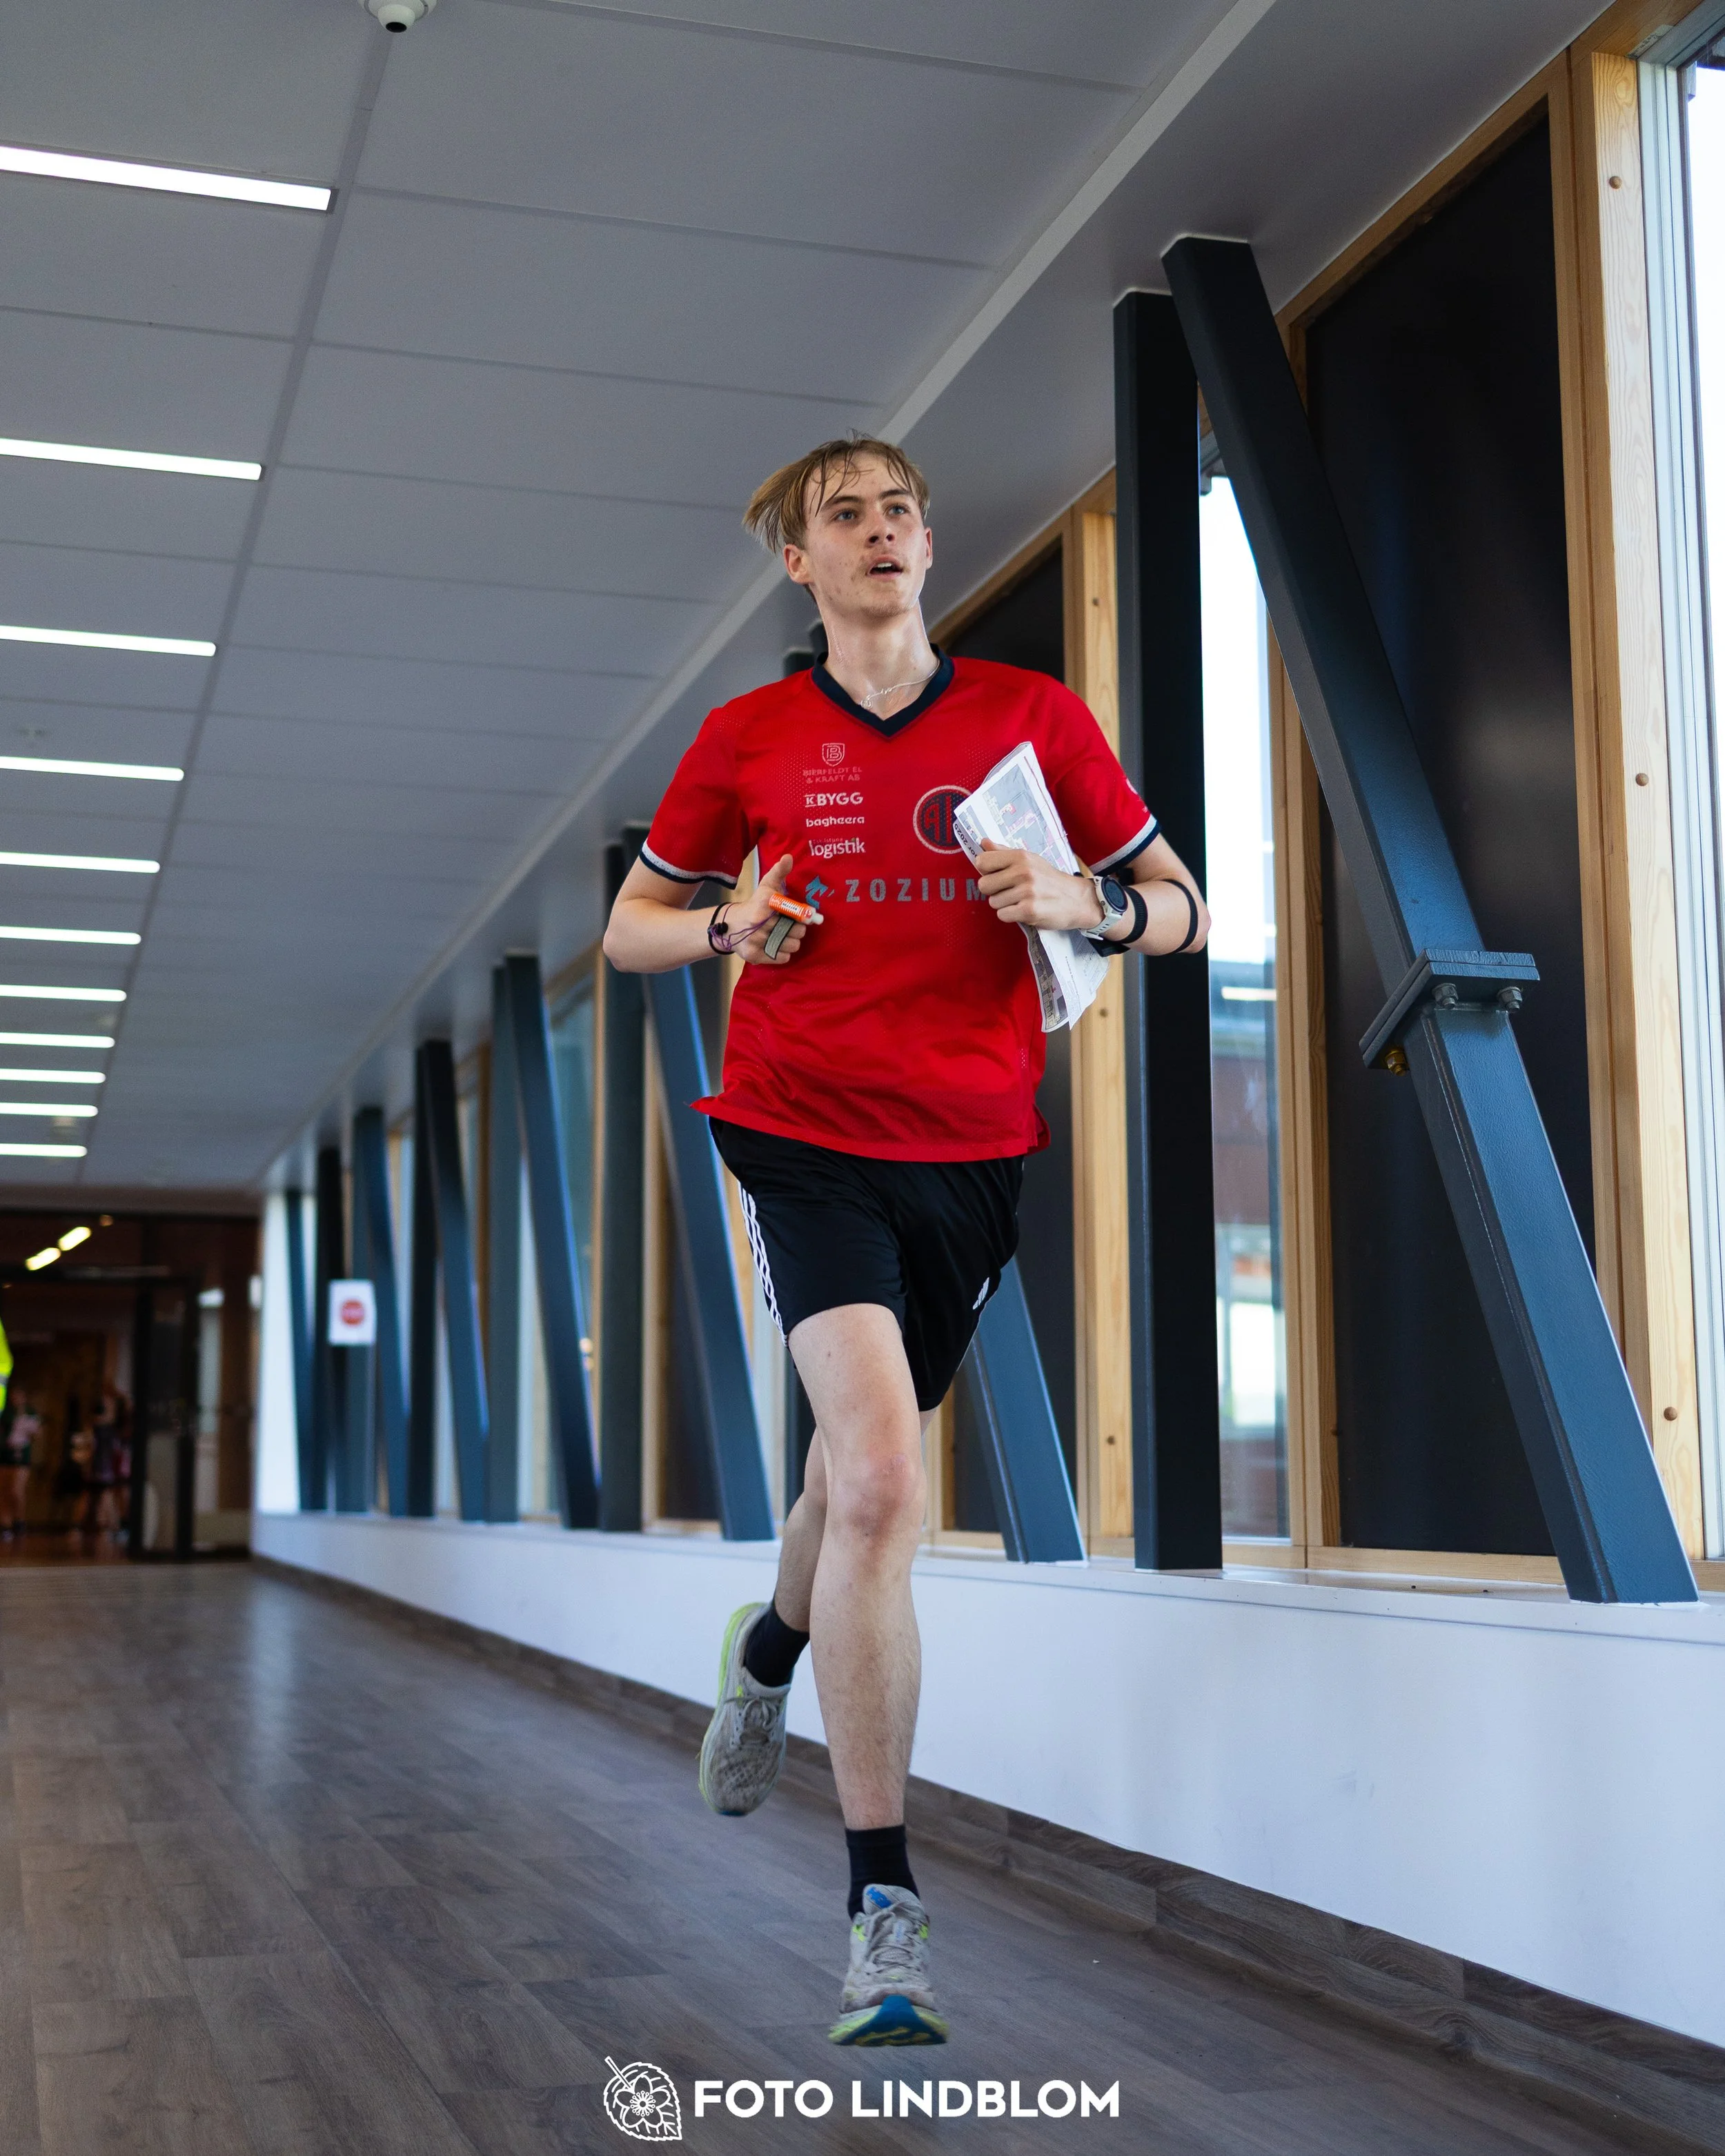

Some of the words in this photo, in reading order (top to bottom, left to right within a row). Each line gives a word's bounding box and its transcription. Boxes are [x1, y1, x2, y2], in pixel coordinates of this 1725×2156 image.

[826, 744, 842, 762] B
[815, 775, 845, 784] KRAFT
[847, 773, 861, 782] AB
[805, 816, 865, 827] bagheera
[954, 823, 968, 846] 2025
[808, 837, 866, 859] logistik
[845, 878, 986, 903] ZOZIUM
